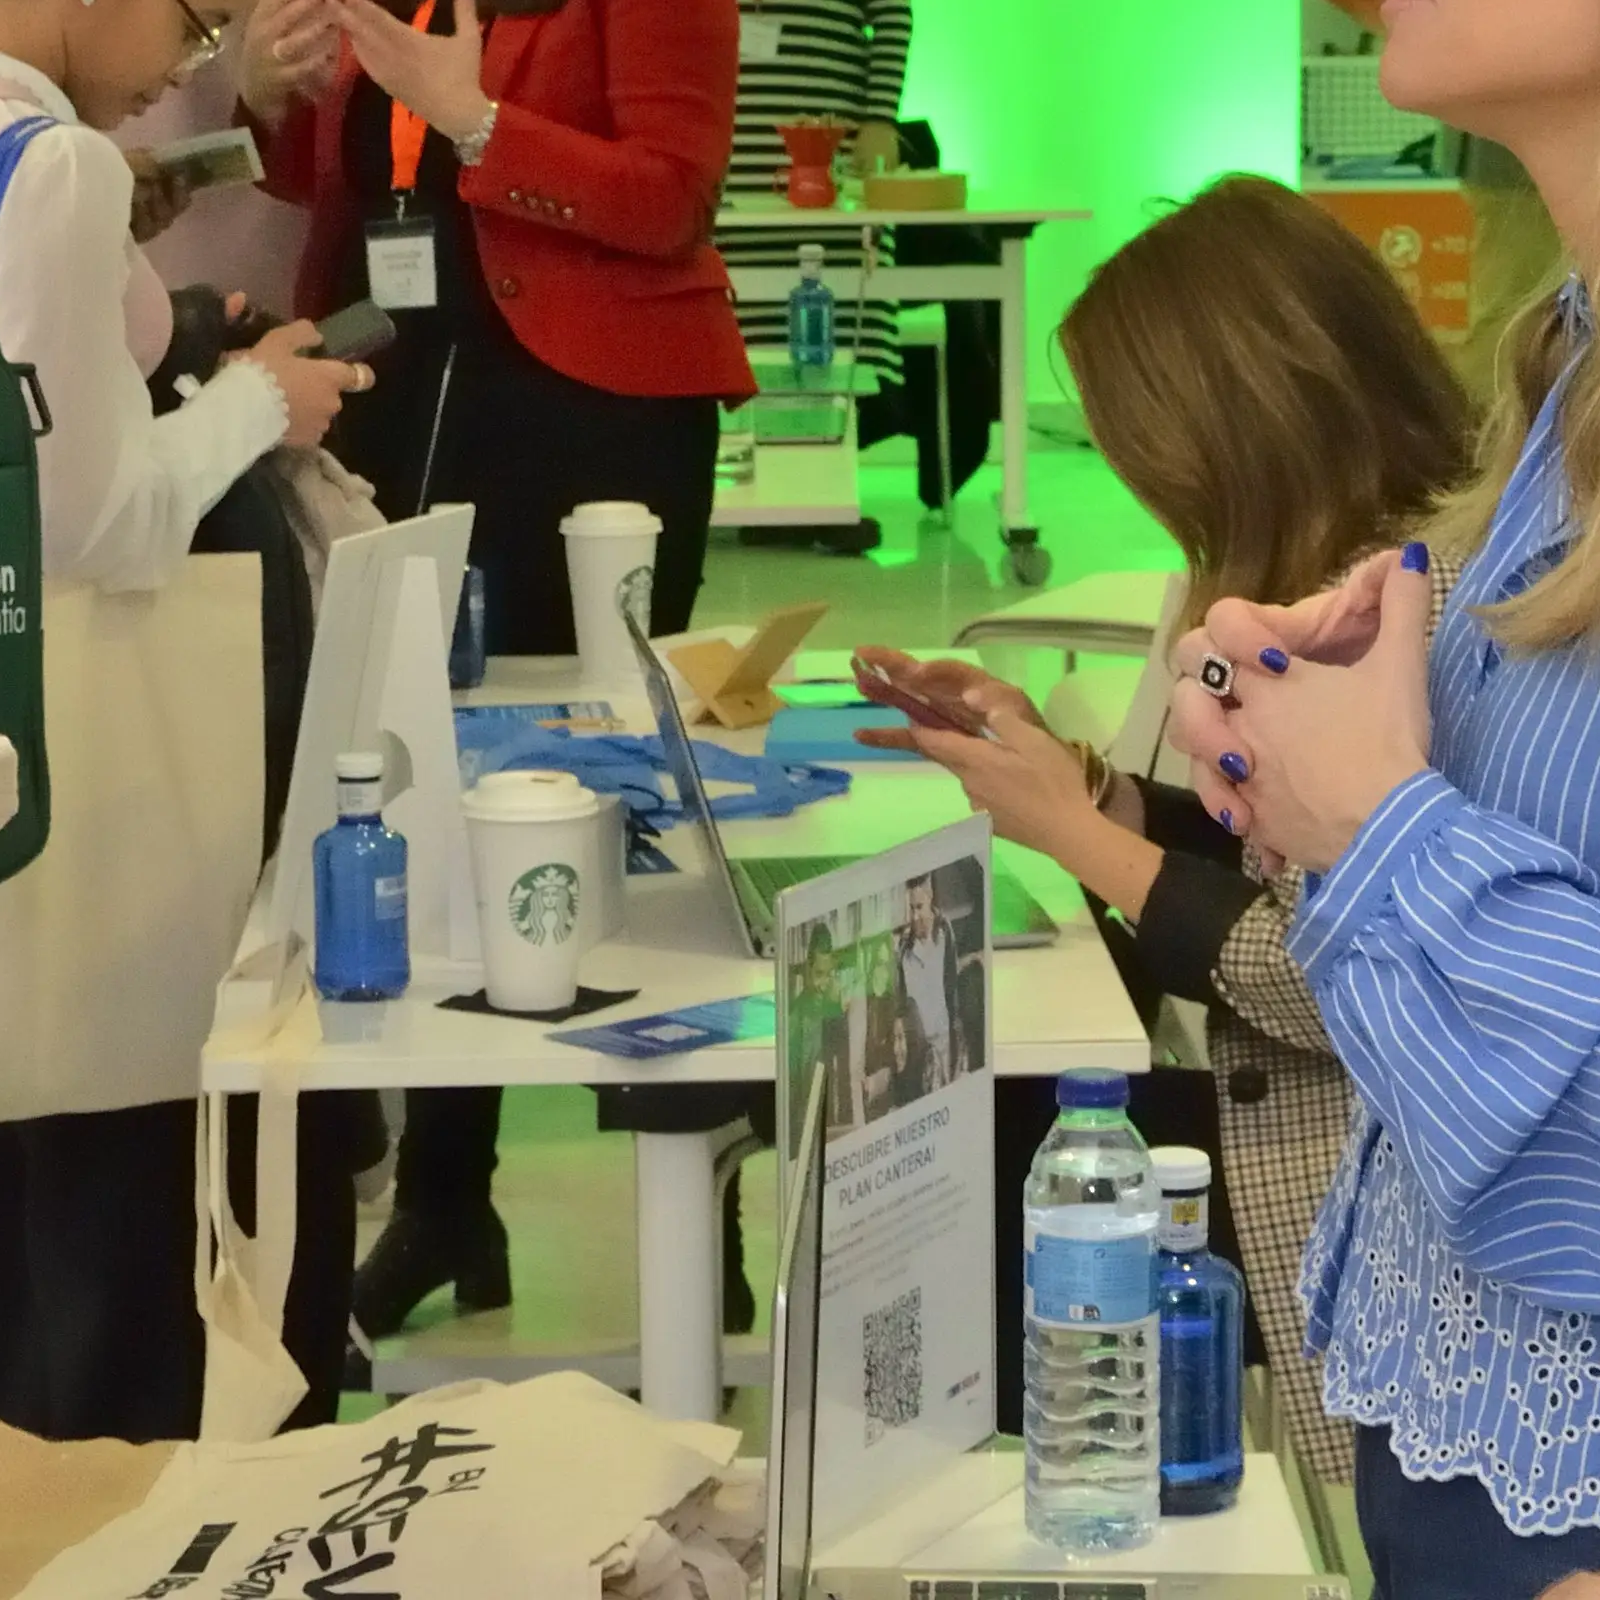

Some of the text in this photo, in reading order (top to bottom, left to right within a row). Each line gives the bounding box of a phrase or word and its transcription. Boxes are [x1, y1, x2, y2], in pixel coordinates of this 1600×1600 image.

[825, 1105, 951, 1185] DESCUBRE NUESTRO
[838, 1177, 873, 1209] PLAN
